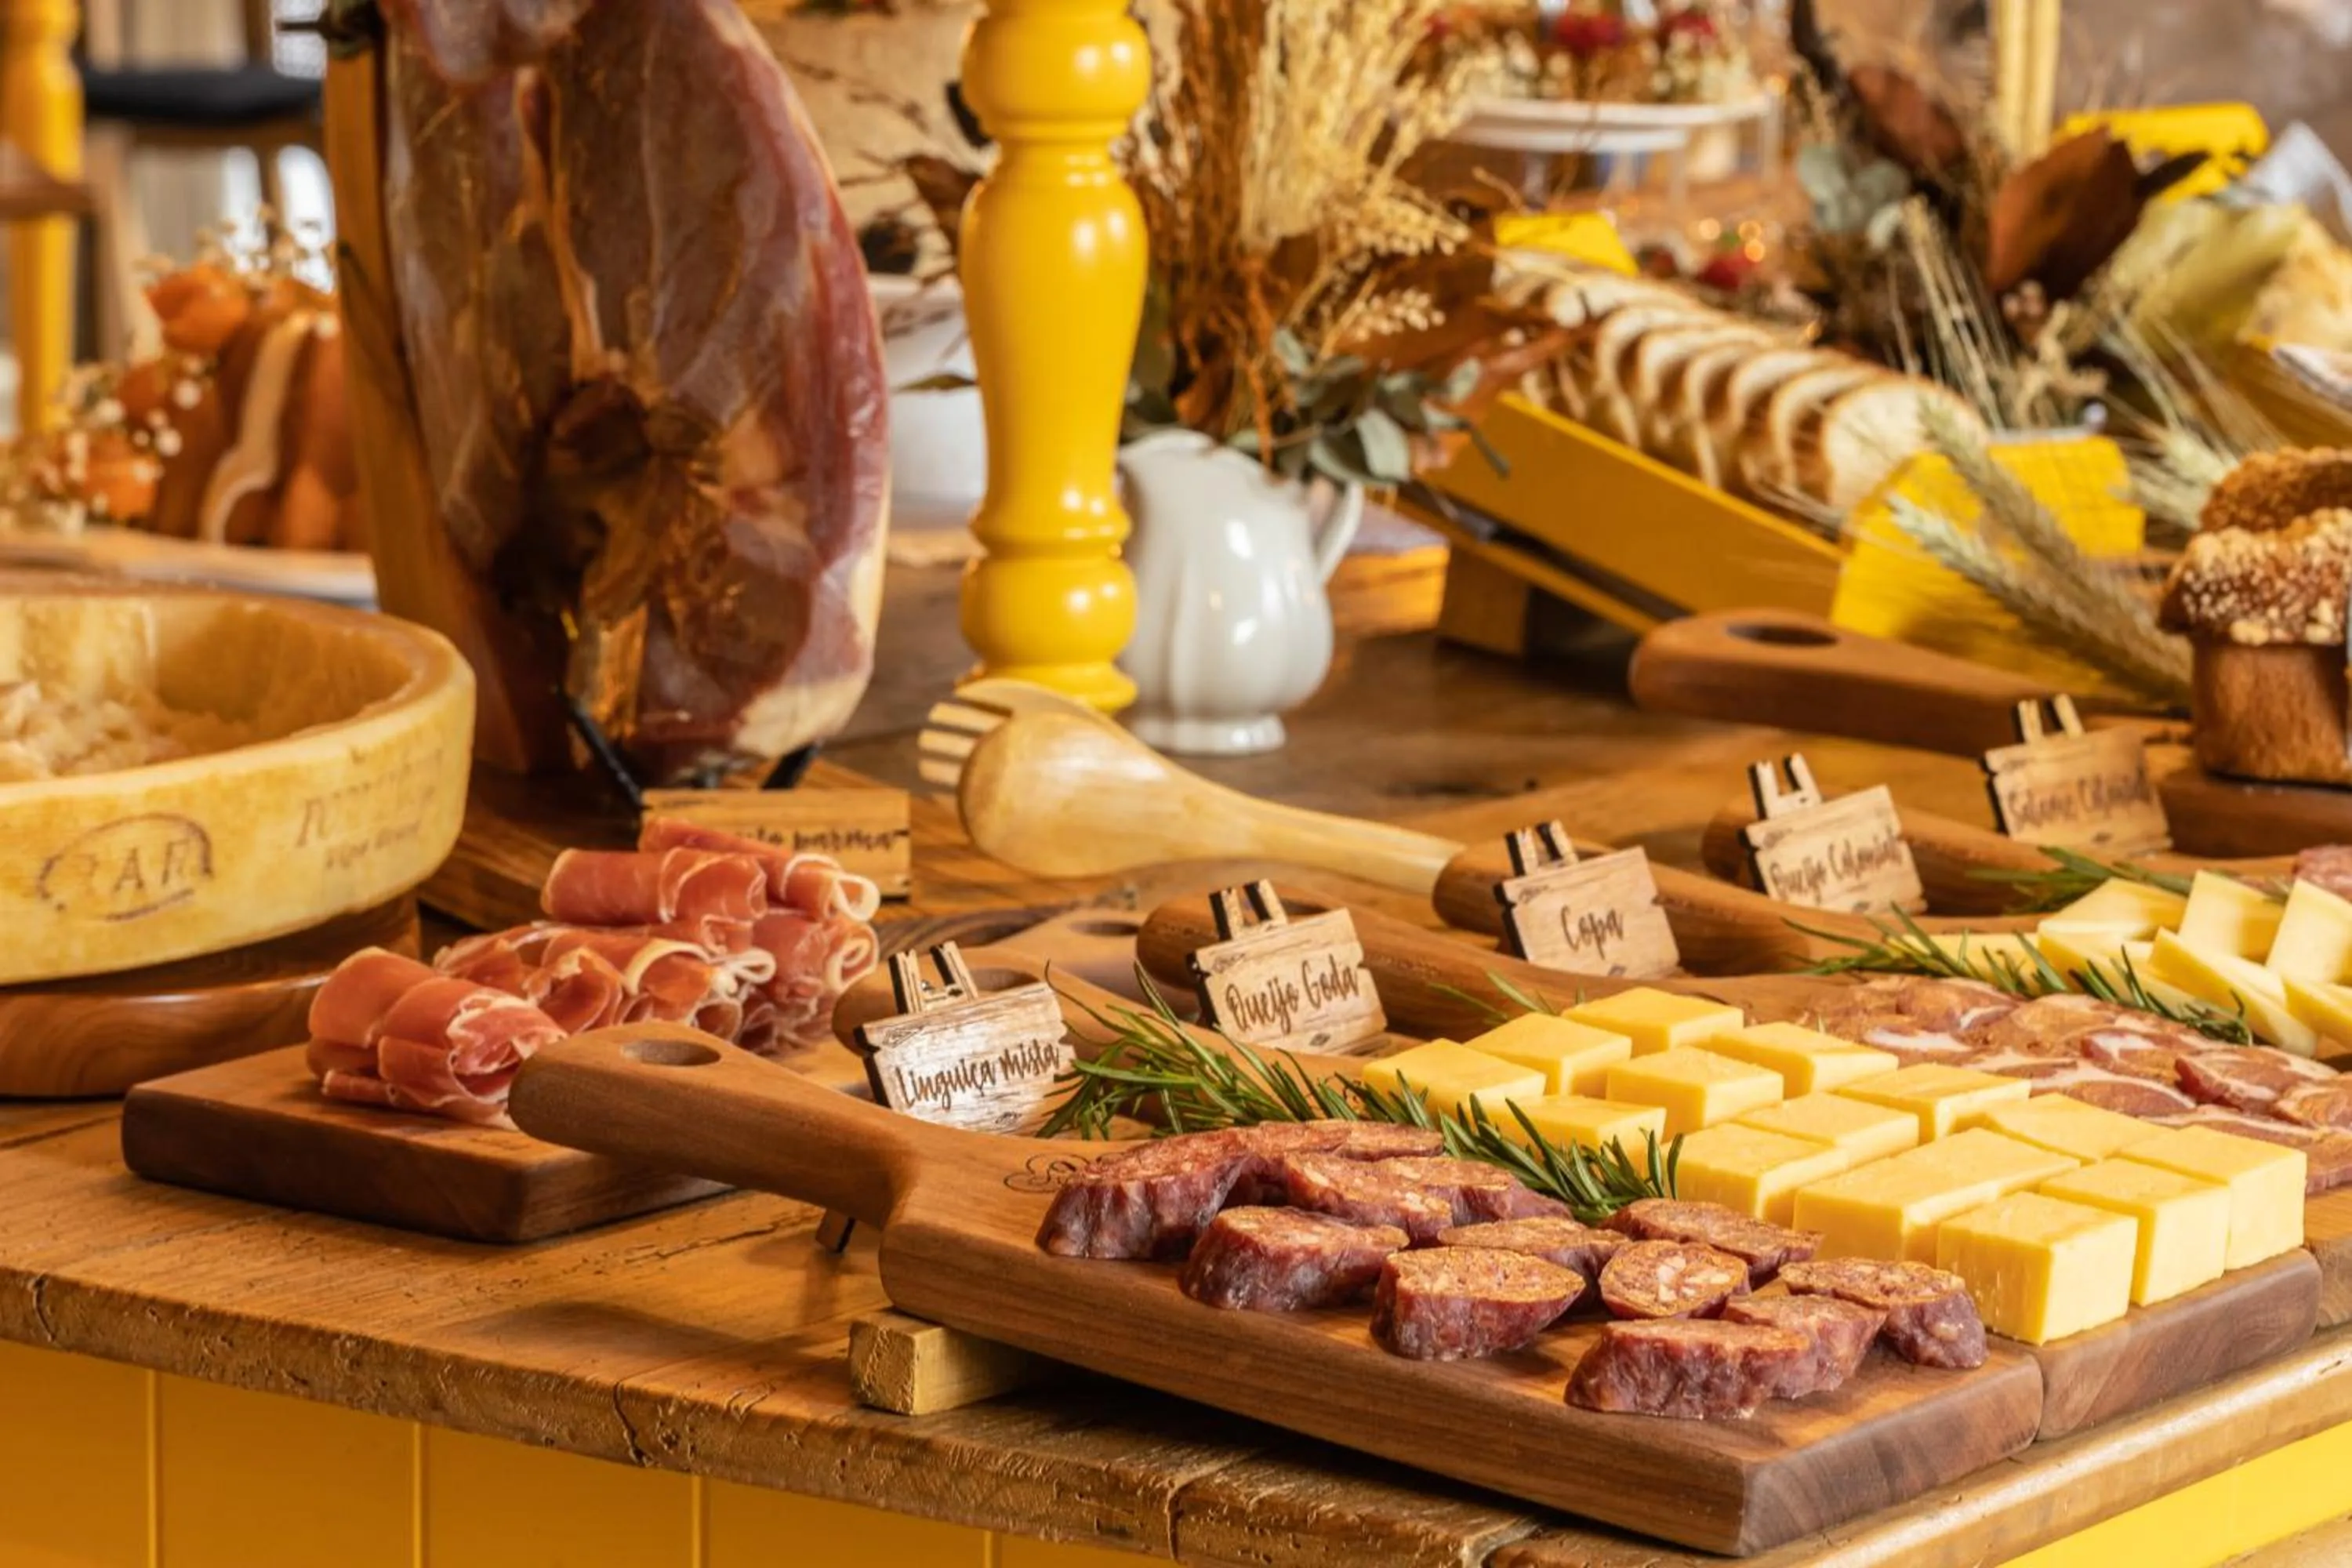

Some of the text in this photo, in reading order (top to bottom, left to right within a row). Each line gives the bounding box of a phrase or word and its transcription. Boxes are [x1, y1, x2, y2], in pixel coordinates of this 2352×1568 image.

[1560, 905, 1624, 960] Copa
[1225, 978, 1298, 1034] Queijo
[895, 1058, 996, 1110] Linguiça
